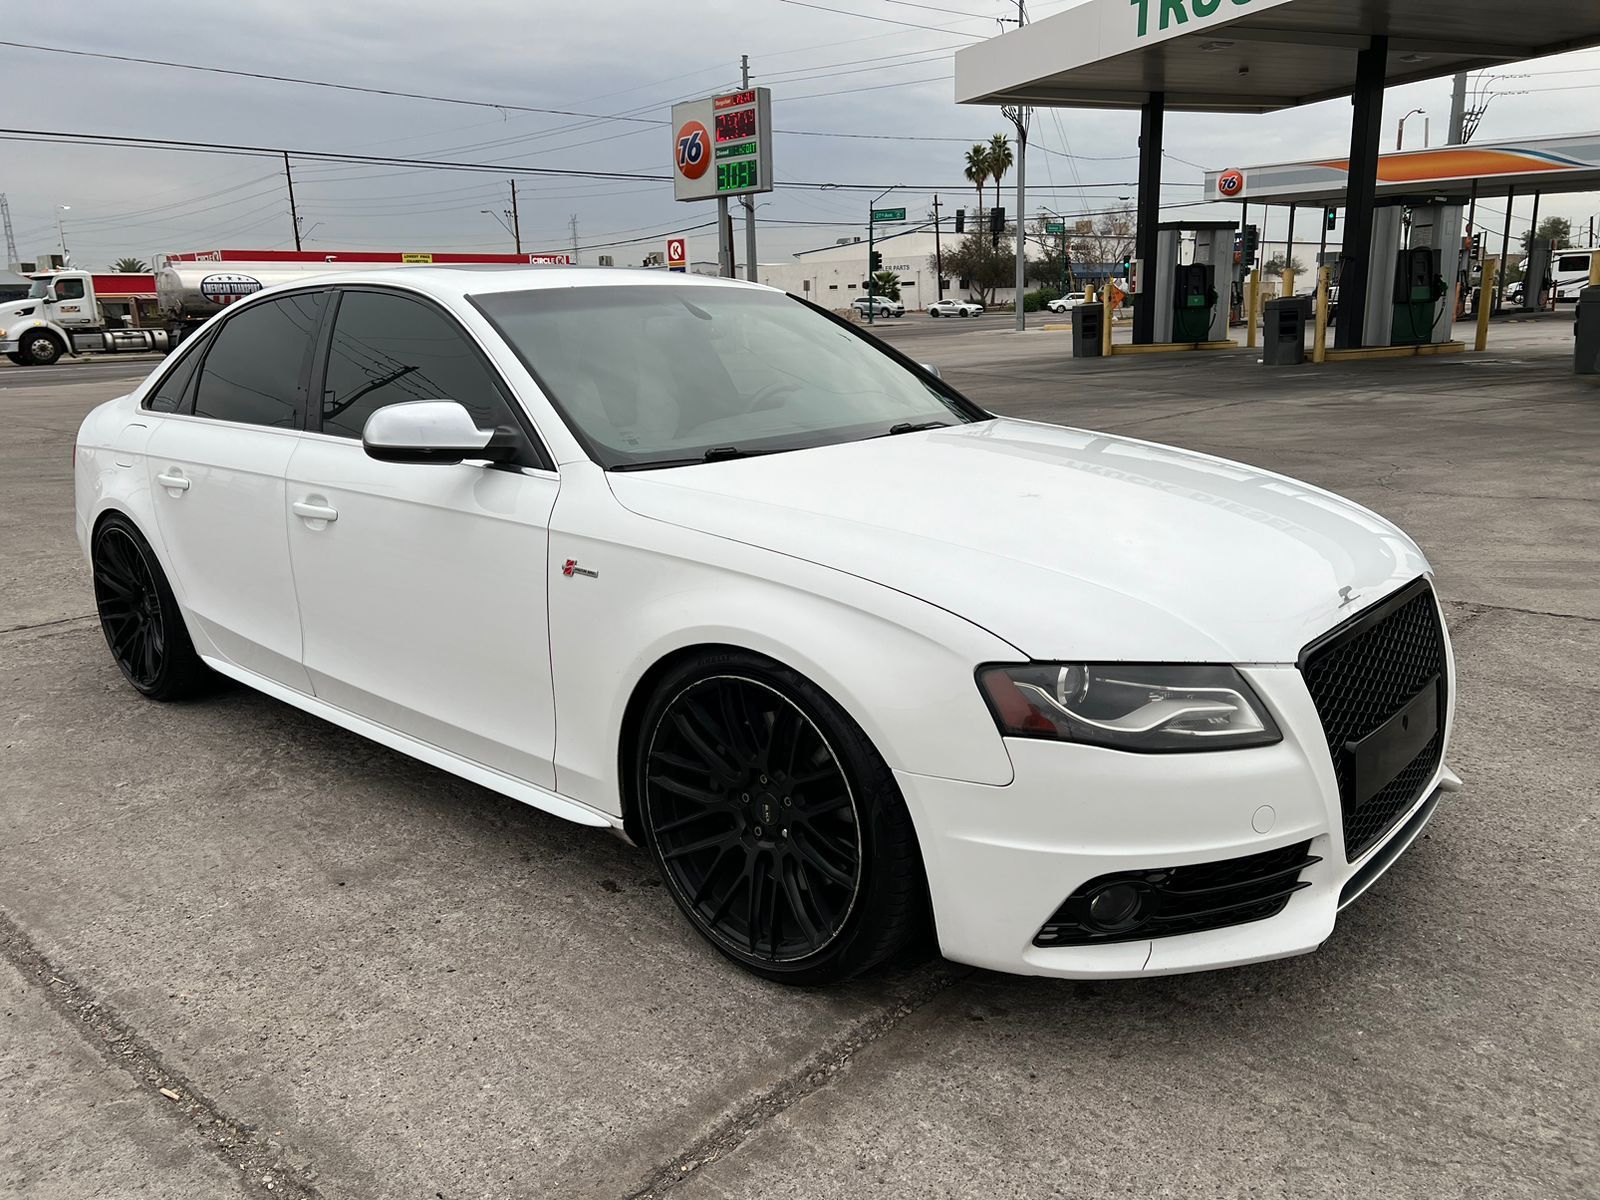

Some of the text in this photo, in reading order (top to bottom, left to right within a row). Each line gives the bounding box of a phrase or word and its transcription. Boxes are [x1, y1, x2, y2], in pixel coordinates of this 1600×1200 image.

[678, 130, 703, 166] 76
[1220, 175, 1238, 191] 76
[532, 256, 555, 264] CIRCLE
[204, 284, 260, 294] AMERICAN TRANSPORT
